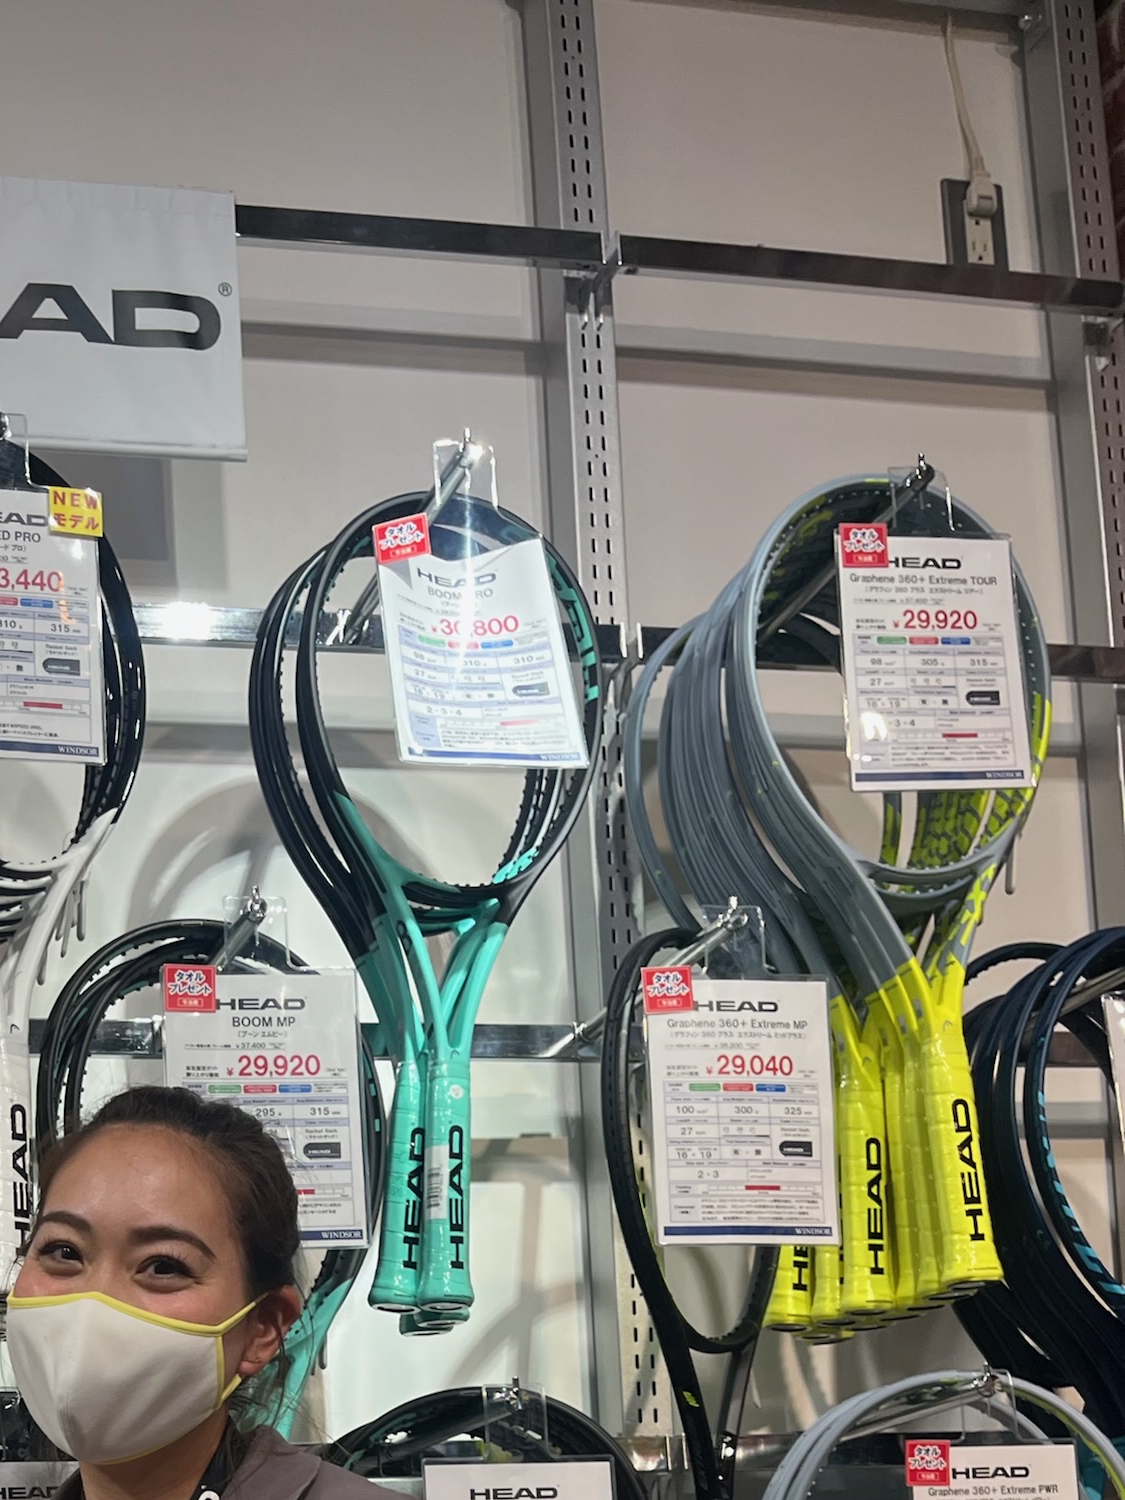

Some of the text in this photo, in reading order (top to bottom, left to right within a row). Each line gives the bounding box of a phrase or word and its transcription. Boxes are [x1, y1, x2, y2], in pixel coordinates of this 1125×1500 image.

[53, 490, 98, 509] NEW
[55, 514, 99, 530] モデル
[15, 531, 41, 542] PRO
[850, 574, 997, 585] Graphene 360+ Extreme TOUR
[903, 610, 977, 630] 29,920
[175, 971, 204, 982] タオル
[655, 972, 681, 984] タオル
[169, 983, 212, 994] プレゼント
[648, 985, 689, 995] プレゼント
[216, 998, 305, 1010] HEAD
[694, 1000, 778, 1012] HEAD
[232, 1017, 295, 1027] BOOM MP
[667, 1019, 807, 1029] Graphene 360+ Extreme MP
[238, 1055, 320, 1077] 29,920
[717, 1055, 793, 1077] 29,040
[952, 1099, 985, 1241] HEAD
[403, 1127, 425, 1270] HEAD
[448, 1125, 464, 1269] HEAD
[865, 1138, 885, 1275] HEAD
[321, 1231, 361, 1239] WINDSOR
[952, 1467, 1030, 1479] HEAD
[470, 1488, 557, 1500] HEAD
[928, 1484, 1058, 1497] Graphene 360+ Extreme PWR
